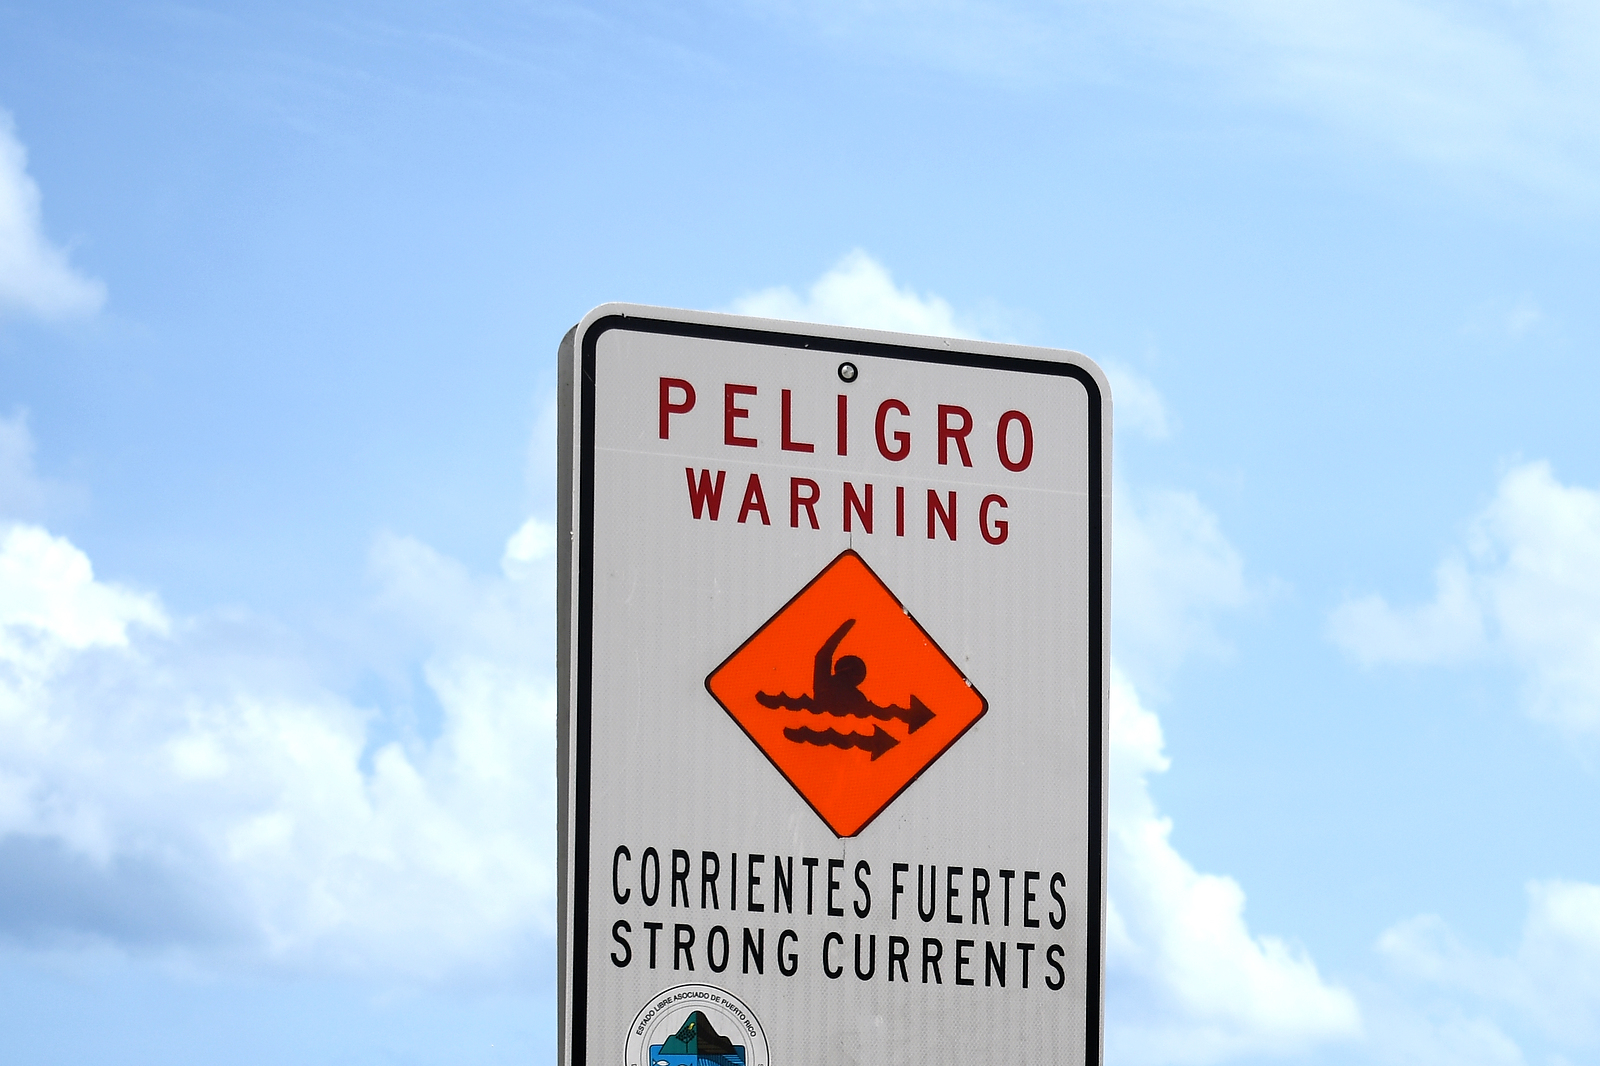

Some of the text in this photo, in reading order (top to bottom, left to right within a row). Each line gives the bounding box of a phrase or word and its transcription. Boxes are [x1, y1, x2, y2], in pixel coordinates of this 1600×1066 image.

[658, 376, 1034, 473] PELIGRO
[685, 466, 1010, 546] WARNING
[612, 844, 1067, 931] CORRIENTES FUERTES
[610, 919, 1066, 991] STRONG CURRENTS
[636, 991, 757, 1038] ESTADO LIBRE ASOCIADO DE PUERTO RICO
